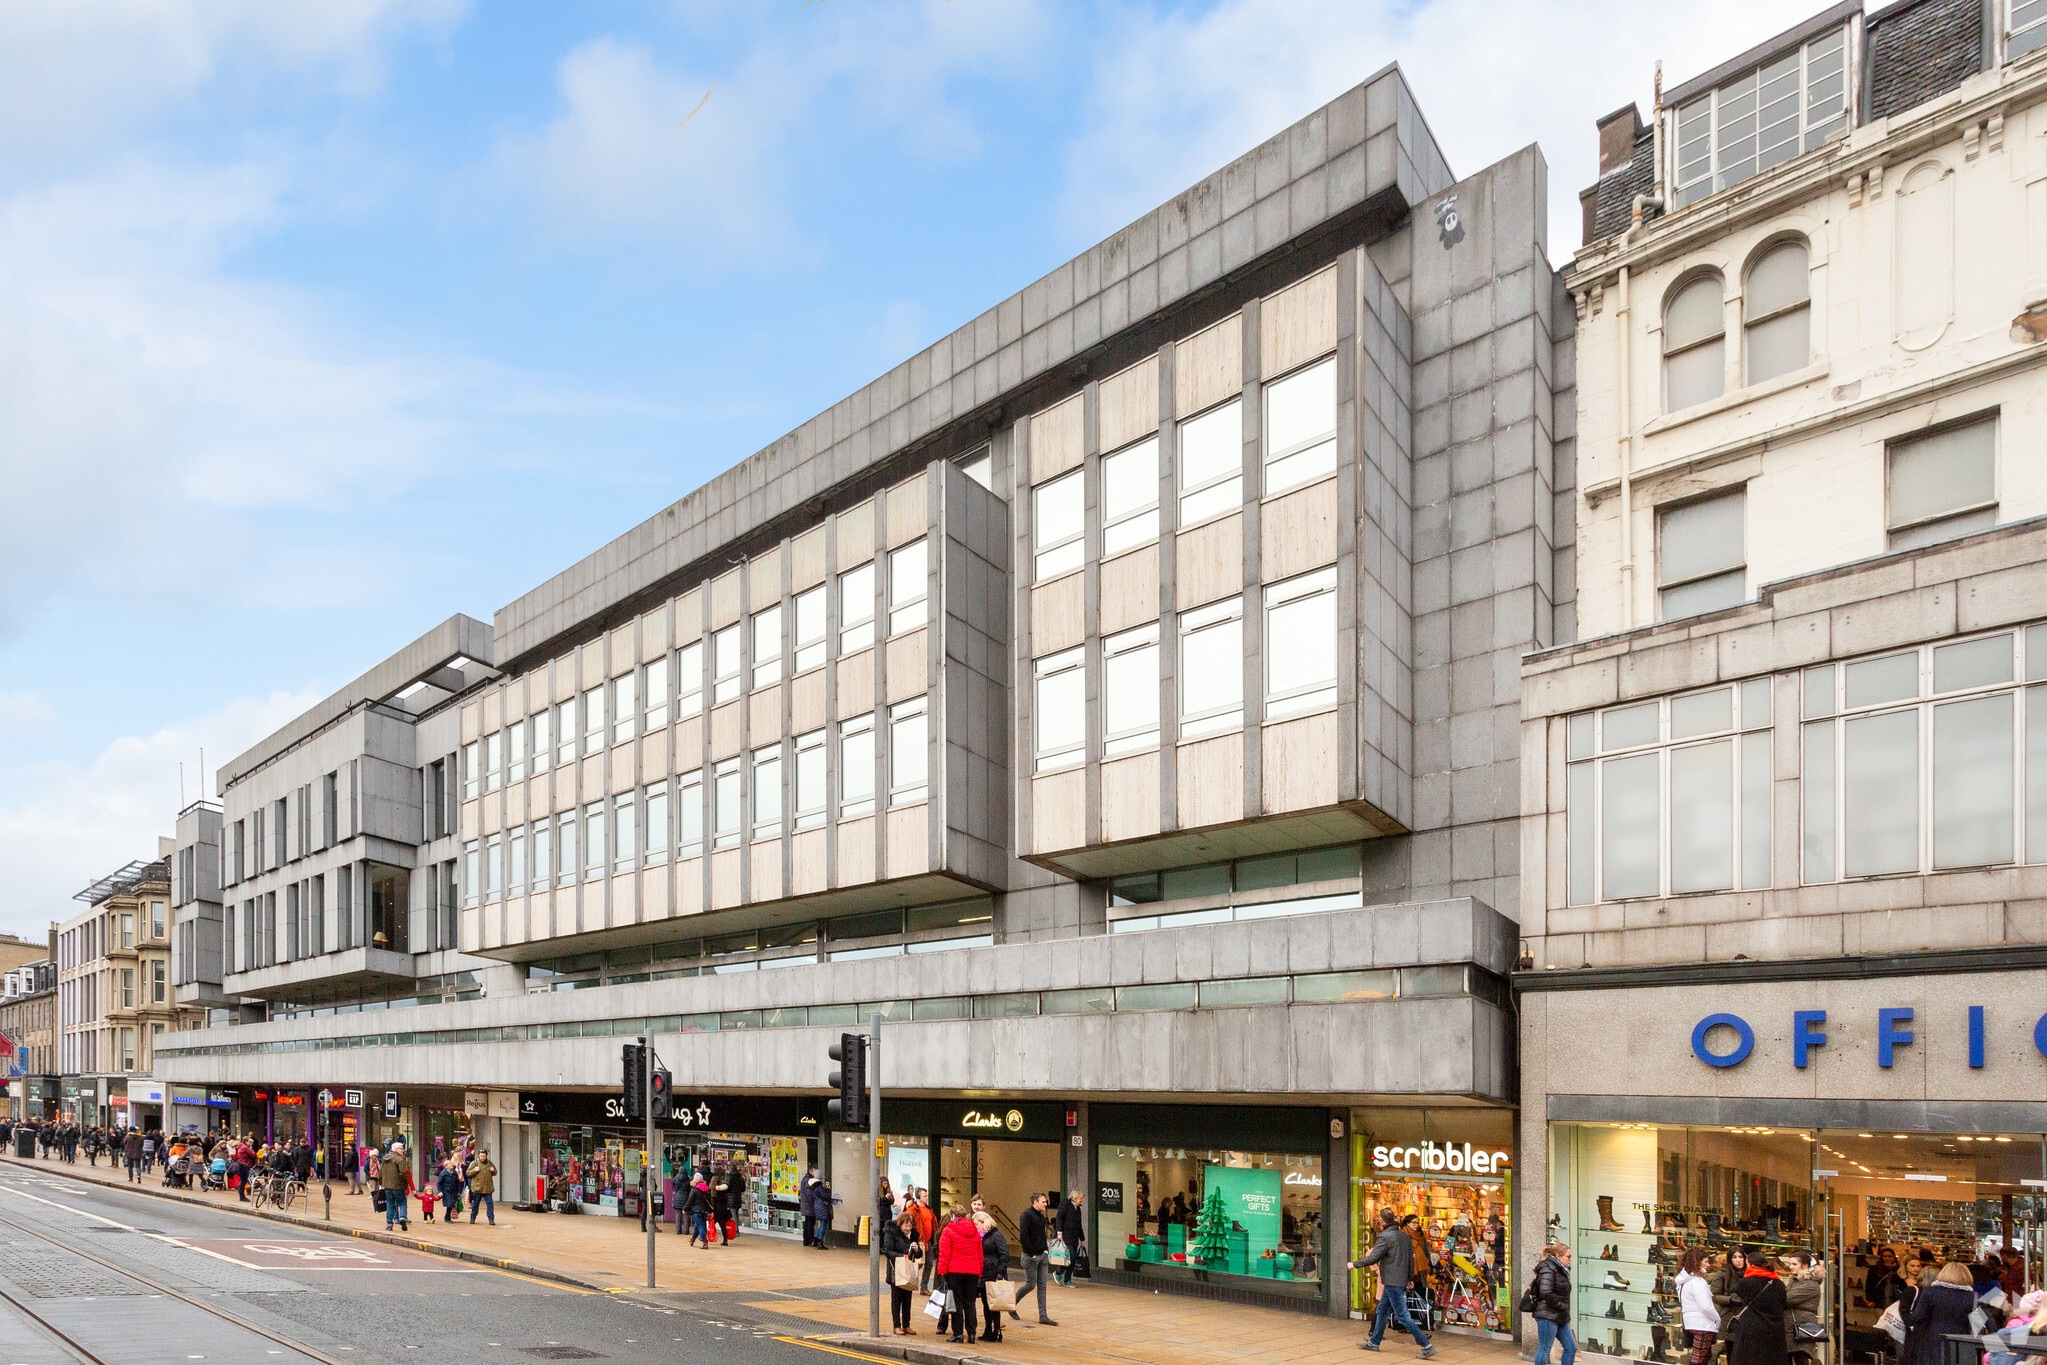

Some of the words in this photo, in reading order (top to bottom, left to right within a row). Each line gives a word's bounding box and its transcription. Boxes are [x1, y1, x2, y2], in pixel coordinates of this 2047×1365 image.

[1691, 1006, 2047, 1067] OFFI
[173, 1096, 202, 1104] SAMSUNG
[466, 1099, 486, 1109] Regus
[962, 1111, 1002, 1127] Clarks
[548, 1137, 568, 1146] more
[877, 1140, 884, 1155] H
[961, 1141, 984, 1153] MES
[1073, 1137, 1081, 1146] 80
[1373, 1140, 1509, 1173] scribbler
[961, 1157, 984, 1171] KIS
[1284, 1172, 1323, 1186] Clarks
[1101, 1187, 1120, 1198] 20%
[1242, 1193, 1276, 1203] PERFECT
[1248, 1202, 1270, 1211] GIFTS
[1632, 1202, 1651, 1211] THE
[1653, 1203, 1680, 1212] SHOE
[1683, 1205, 1724, 1215] DIARIES
[1359, 1196, 1371, 1304] scrbbler
